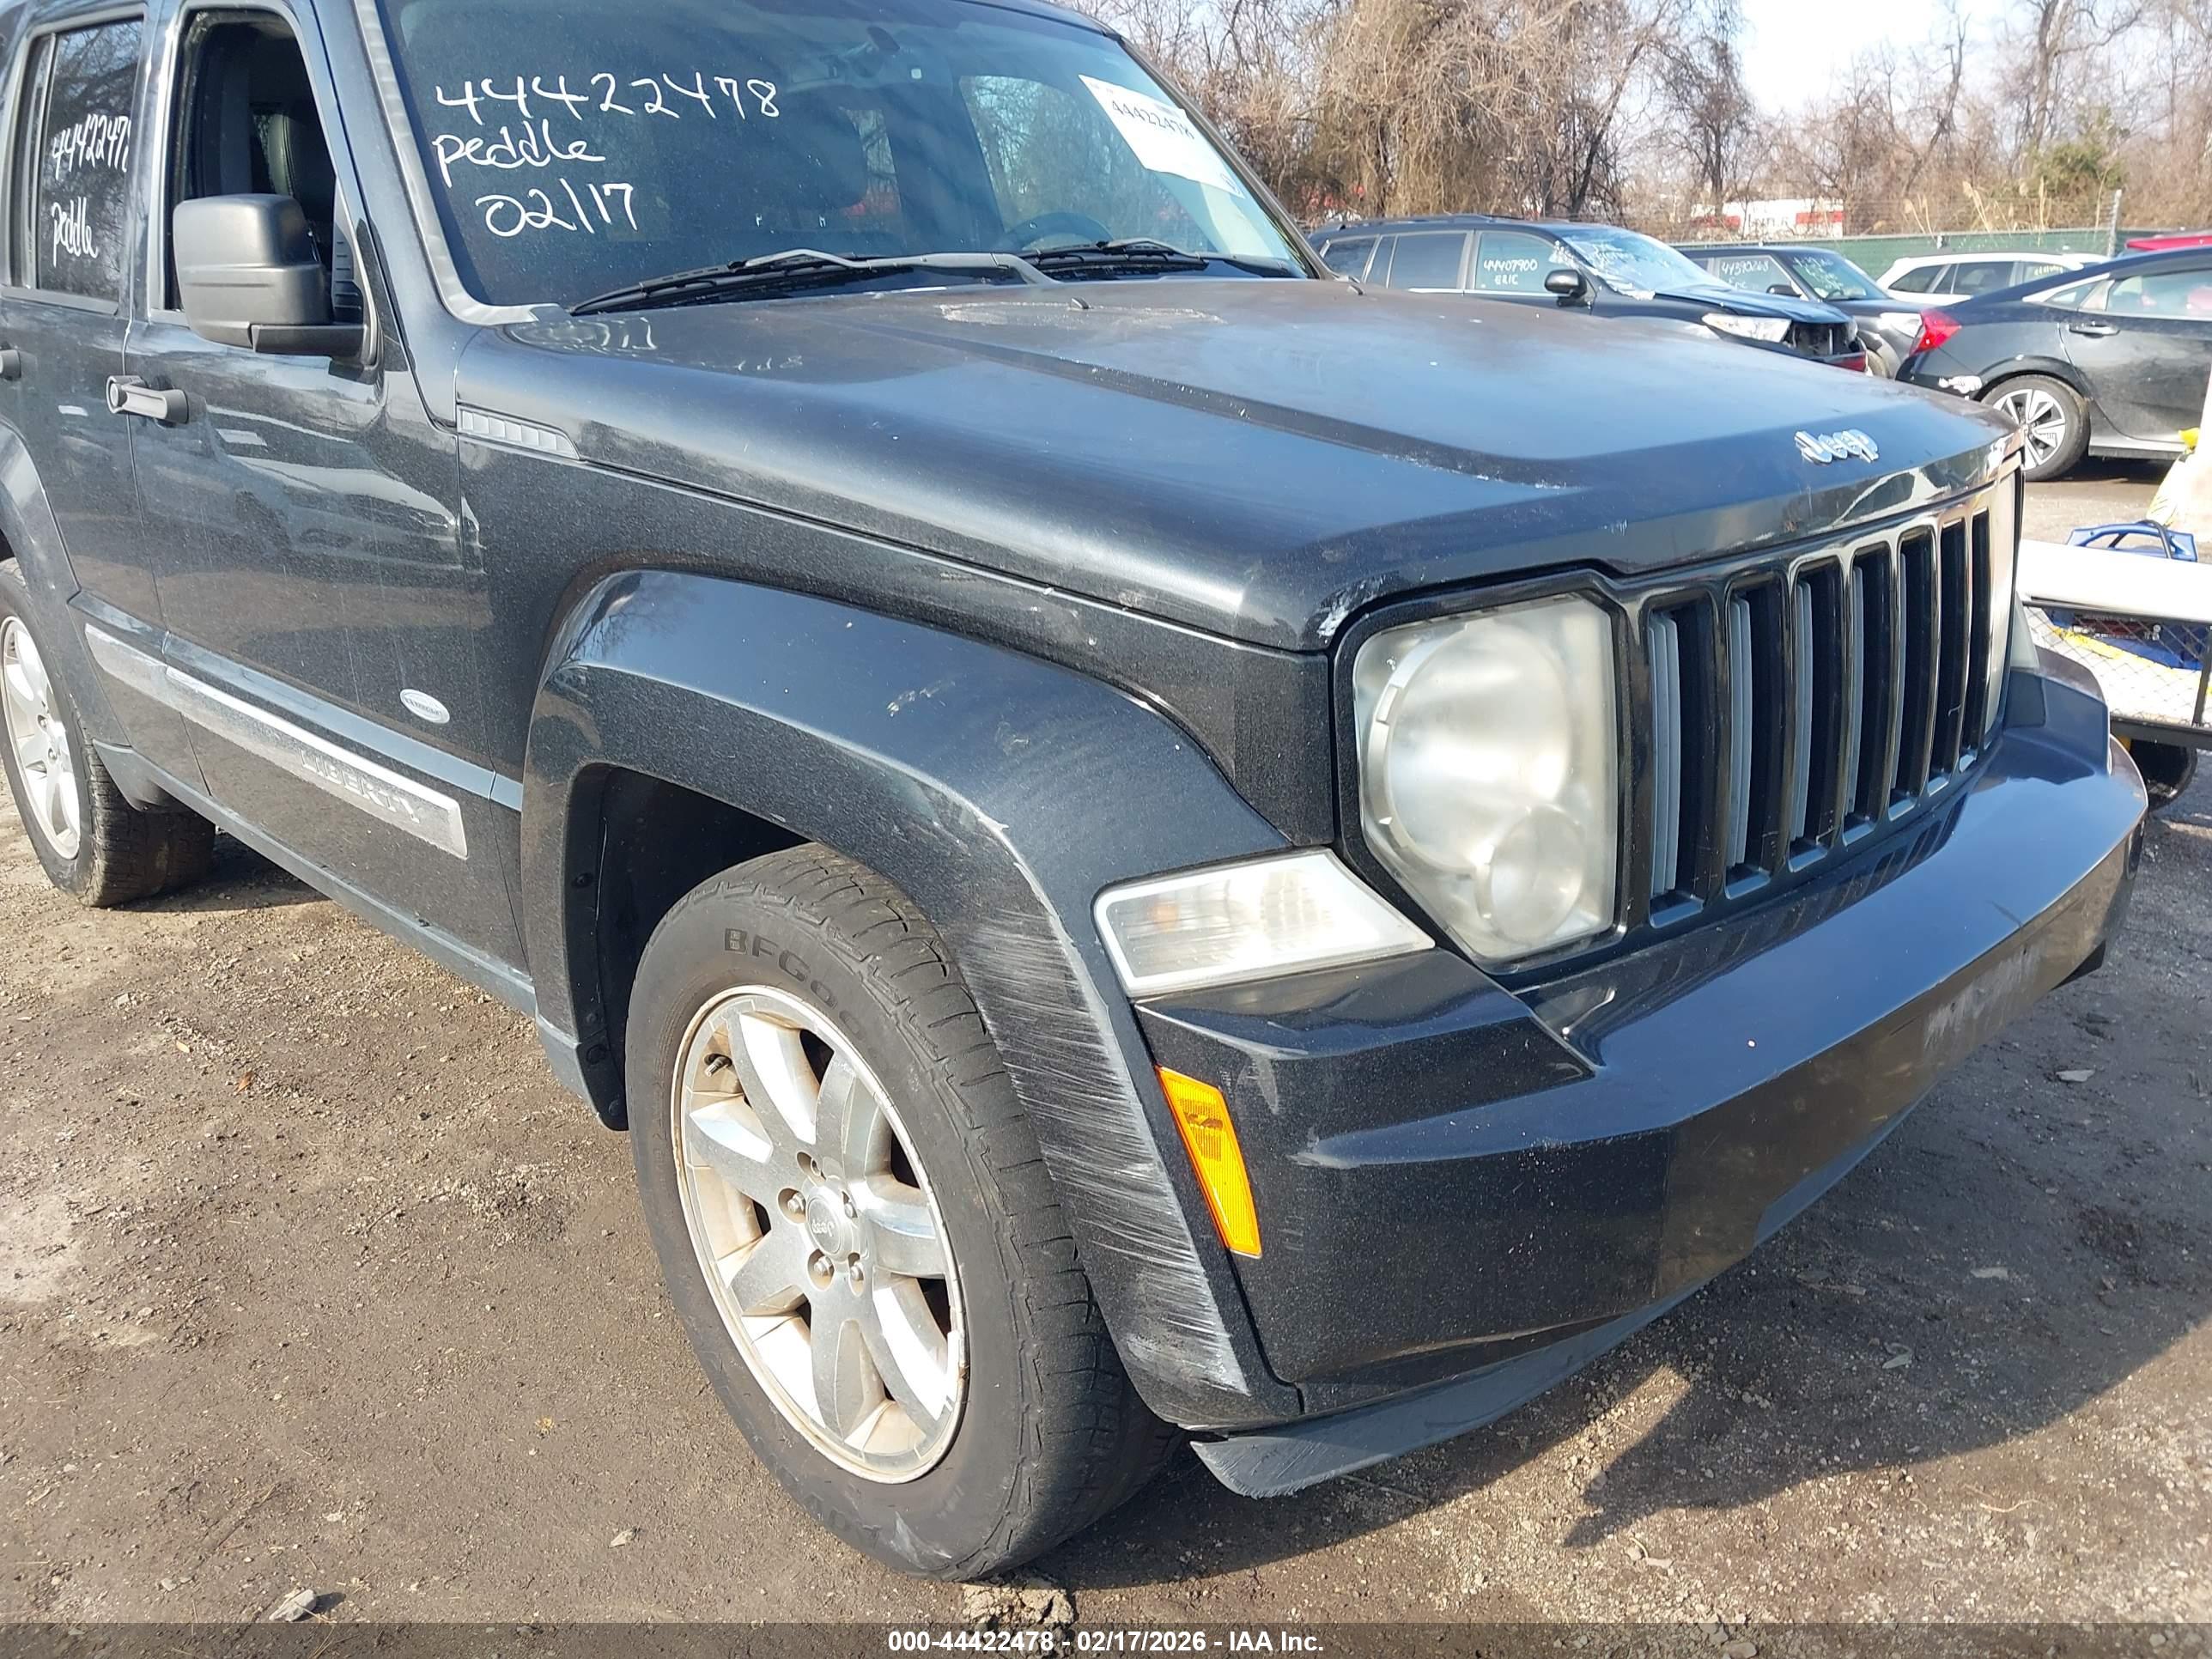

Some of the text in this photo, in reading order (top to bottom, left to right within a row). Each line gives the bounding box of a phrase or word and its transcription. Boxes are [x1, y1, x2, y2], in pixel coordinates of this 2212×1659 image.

[435, 71, 779, 125] 44422478
[1484, 258, 1538, 272] 44407900
[1794, 428, 1879, 465] Jeep
[300, 749, 421, 824] LIBERTY
